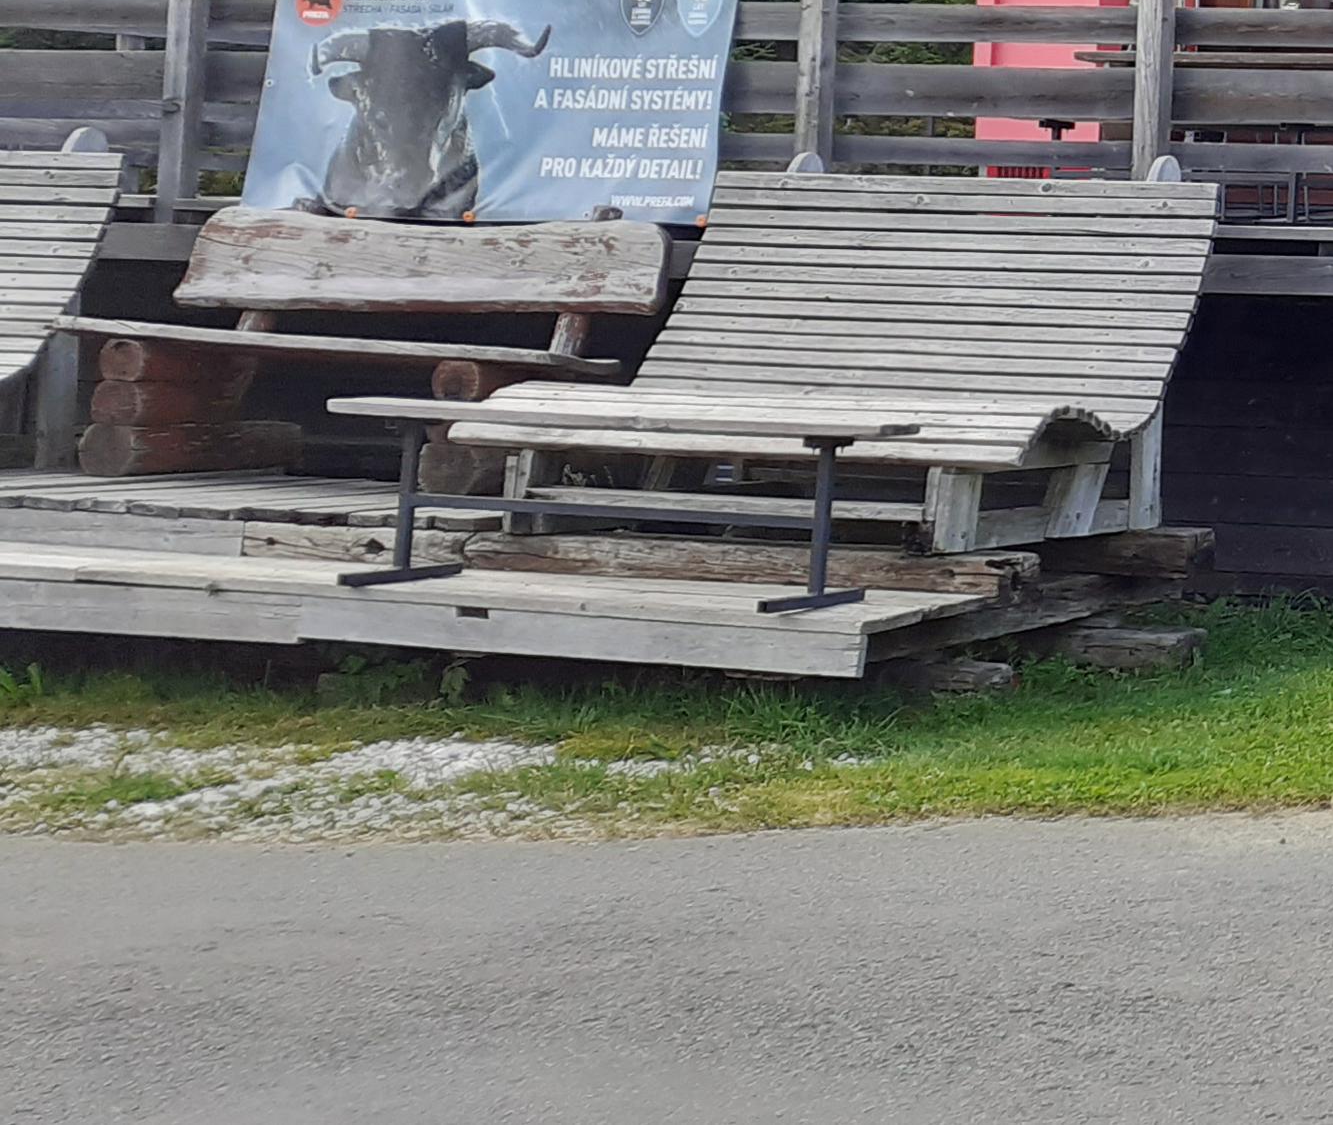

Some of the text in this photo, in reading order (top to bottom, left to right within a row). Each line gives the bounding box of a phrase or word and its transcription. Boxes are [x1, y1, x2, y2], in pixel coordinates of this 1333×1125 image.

[550, 55, 718, 80] HLINÍKOVÉ STŘEŠNÍ
[533, 85, 713, 110] A FASÁDNÍ SYSTÉMY!
[592, 123, 709, 148] MÁME ŘEŠENÍ
[540, 154, 704, 180] PRO KAŽDÝ DETAIL!
